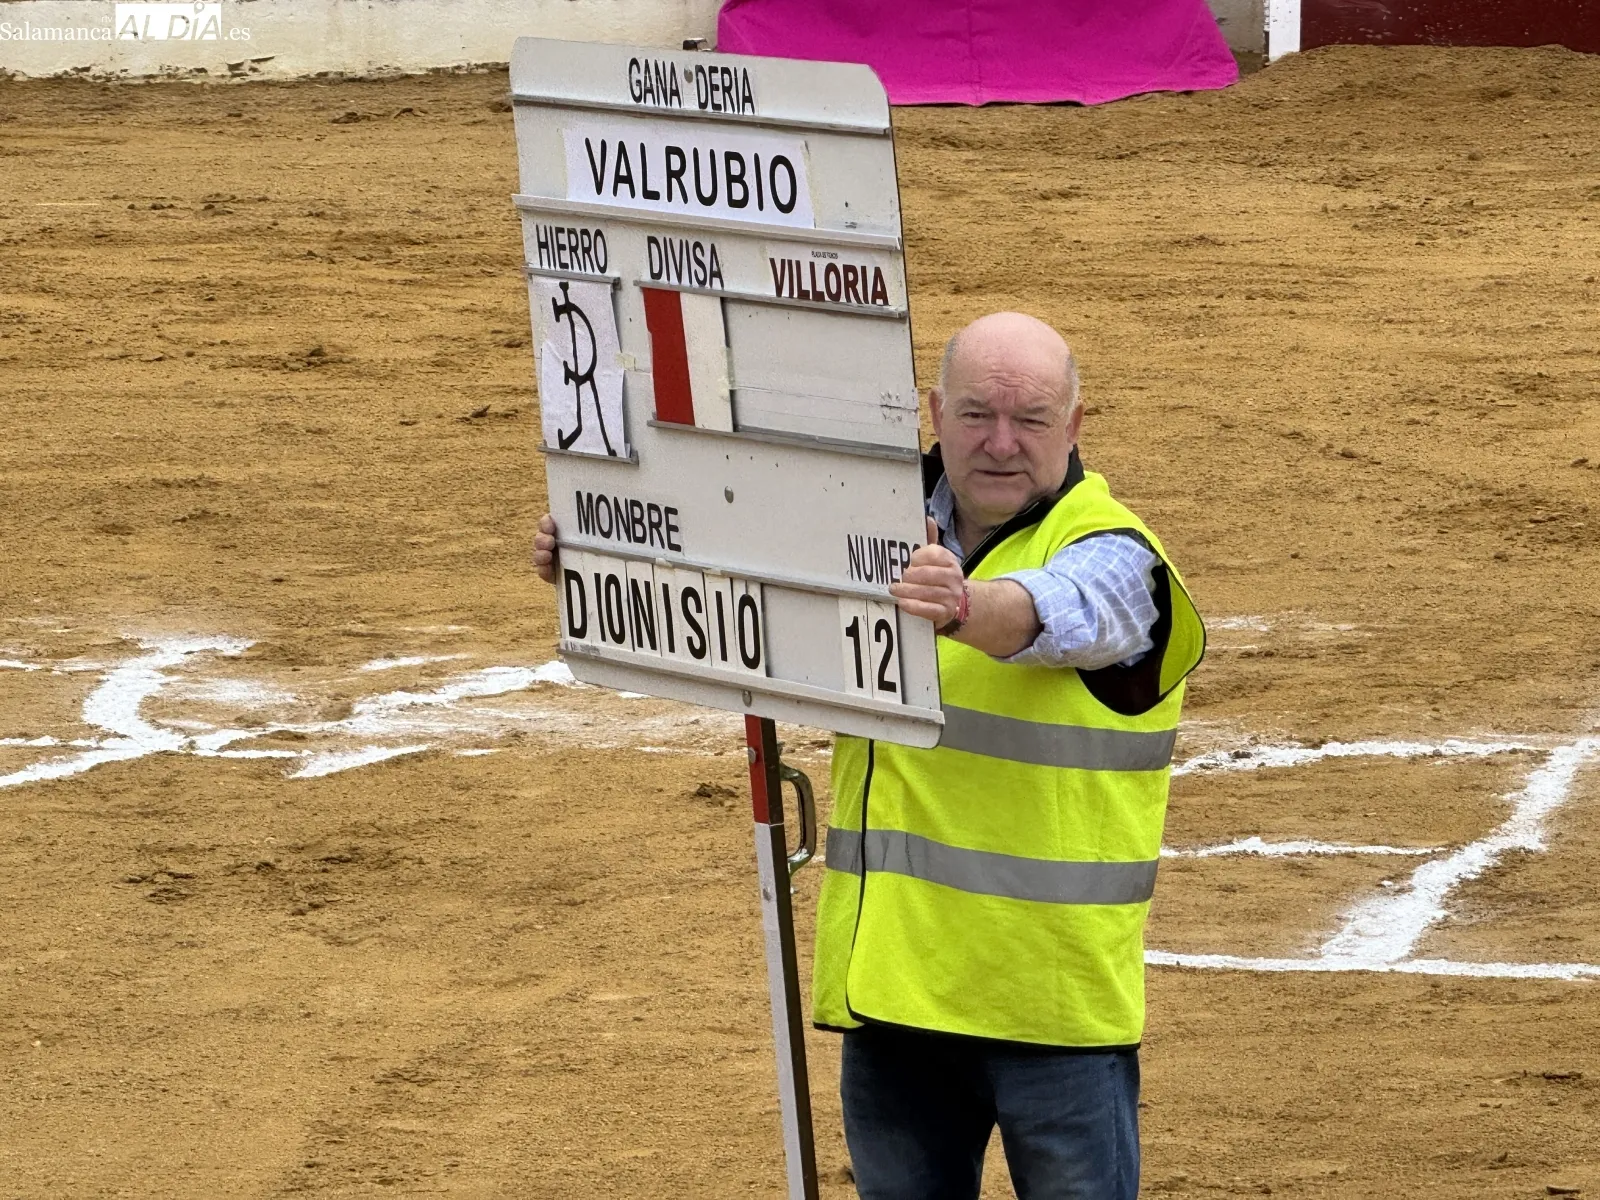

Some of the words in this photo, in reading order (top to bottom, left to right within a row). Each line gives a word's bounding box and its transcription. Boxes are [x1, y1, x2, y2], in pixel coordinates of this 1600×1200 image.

[584, 137, 798, 214] VALRUBIO
[535, 224, 608, 274] HIERRO
[646, 235, 725, 290] DIVISA
[769, 257, 890, 307] VILLORIA
[575, 490, 682, 552] MONBRE
[847, 533, 921, 585] NUMER
[564, 568, 761, 671] DIONISIO
[845, 615, 897, 694] 12
